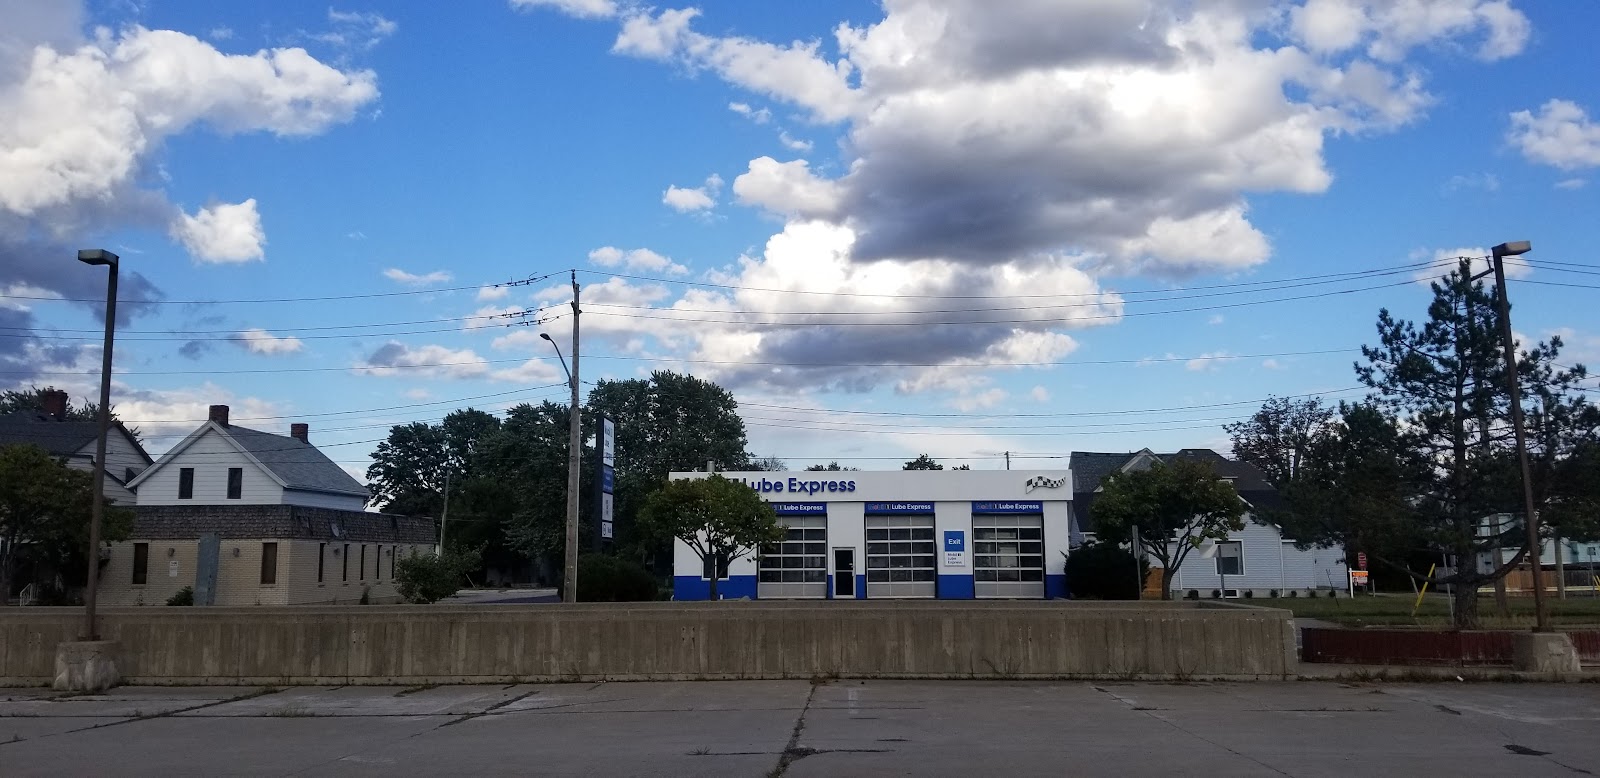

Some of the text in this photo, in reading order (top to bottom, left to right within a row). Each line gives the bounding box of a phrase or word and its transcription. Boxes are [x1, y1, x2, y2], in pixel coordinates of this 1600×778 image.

[788, 477, 856, 495] Express
[800, 504, 824, 512] Express
[907, 503, 931, 511] Express
[1015, 503, 1039, 511] Express
